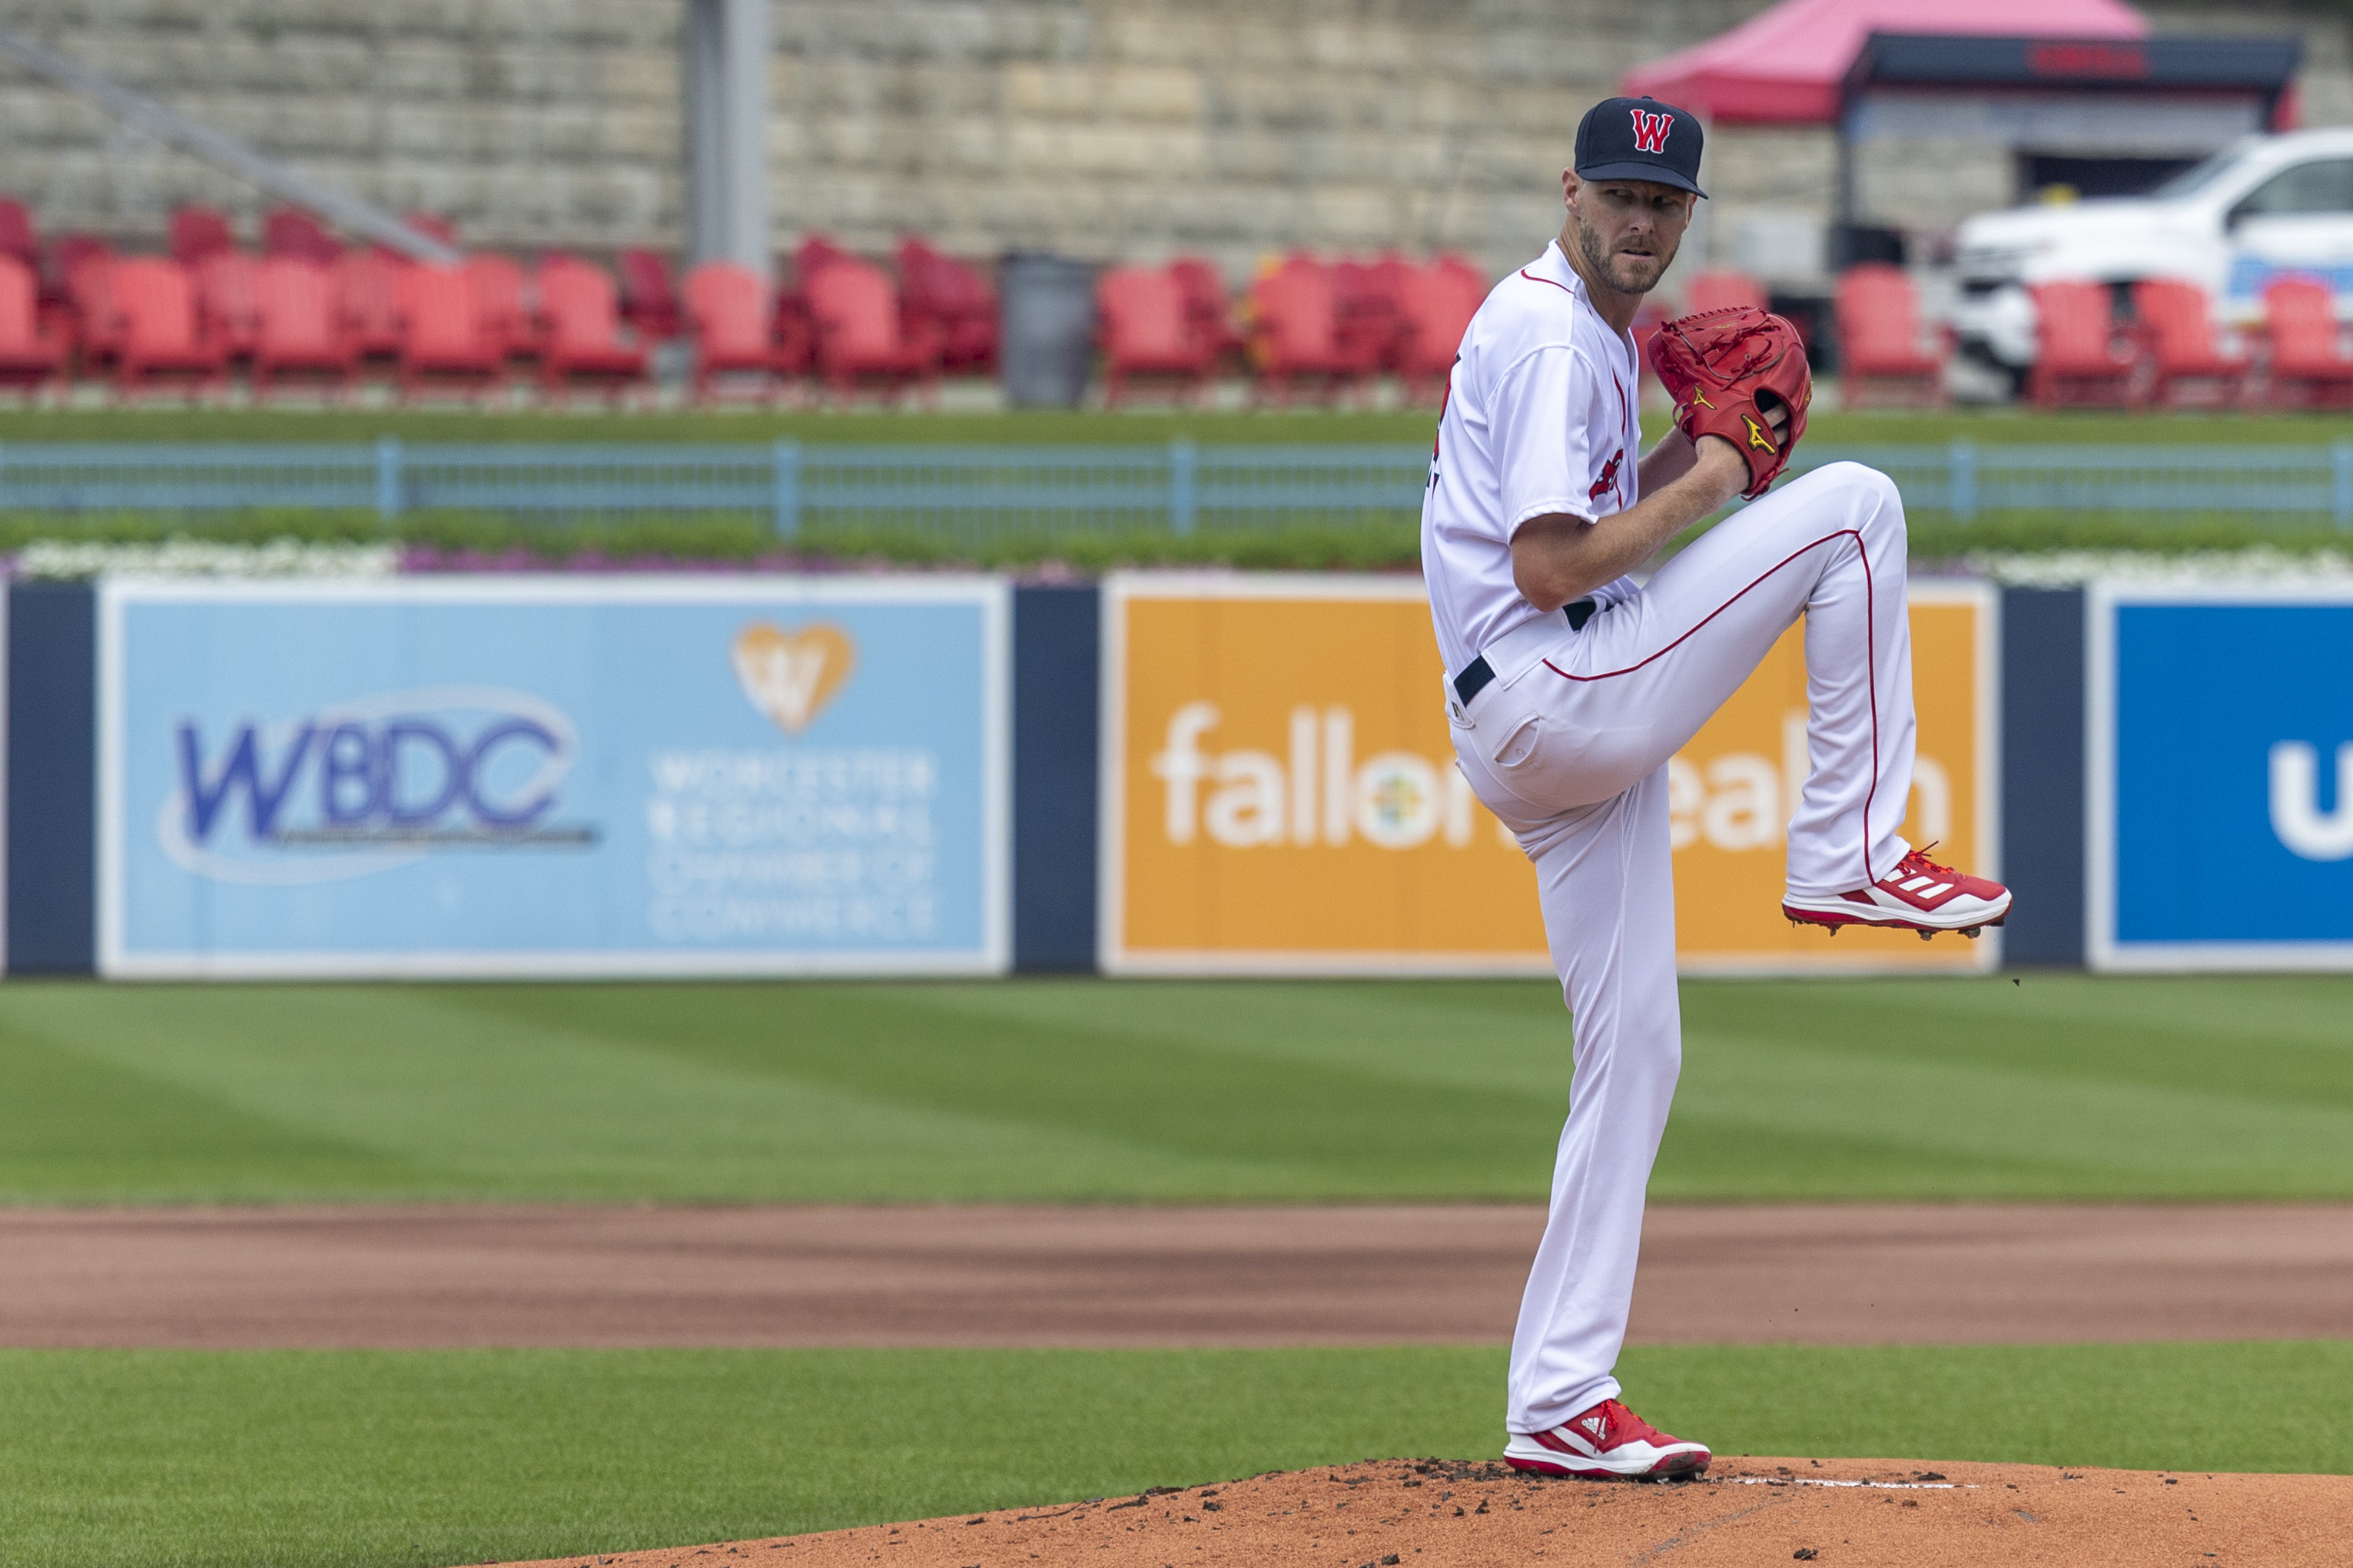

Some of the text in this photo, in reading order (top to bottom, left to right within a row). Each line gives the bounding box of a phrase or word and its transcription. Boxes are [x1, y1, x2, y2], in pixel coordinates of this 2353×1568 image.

[1630, 108, 1674, 154] W
[175, 714, 564, 844] WBDC
[649, 750, 937, 801] WORCESTER
[648, 799, 933, 847] REGIONAL
